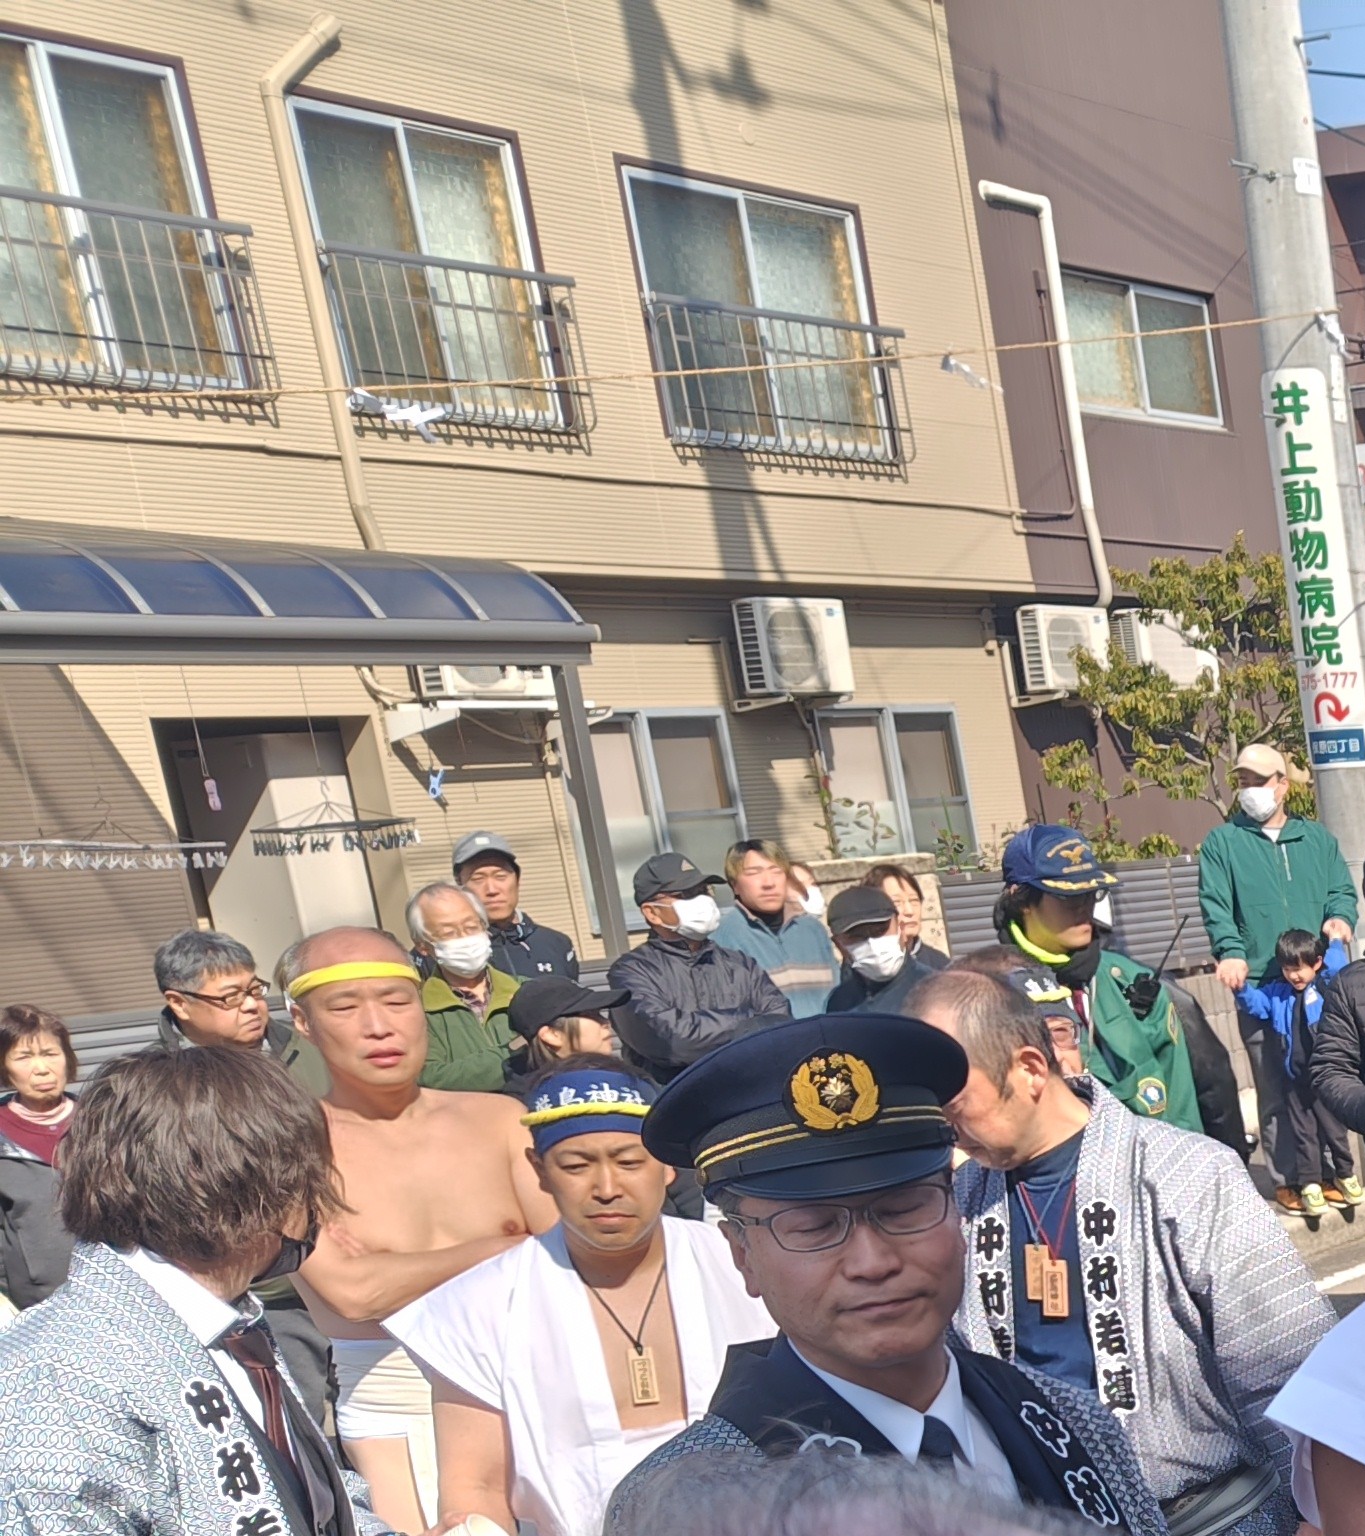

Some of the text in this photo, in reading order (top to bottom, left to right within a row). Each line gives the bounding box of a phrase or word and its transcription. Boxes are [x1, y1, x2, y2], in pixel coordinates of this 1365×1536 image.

[1270, 381, 1344, 668] 井上動物病院
[1081, 1201, 1136, 1412] 中村若連
